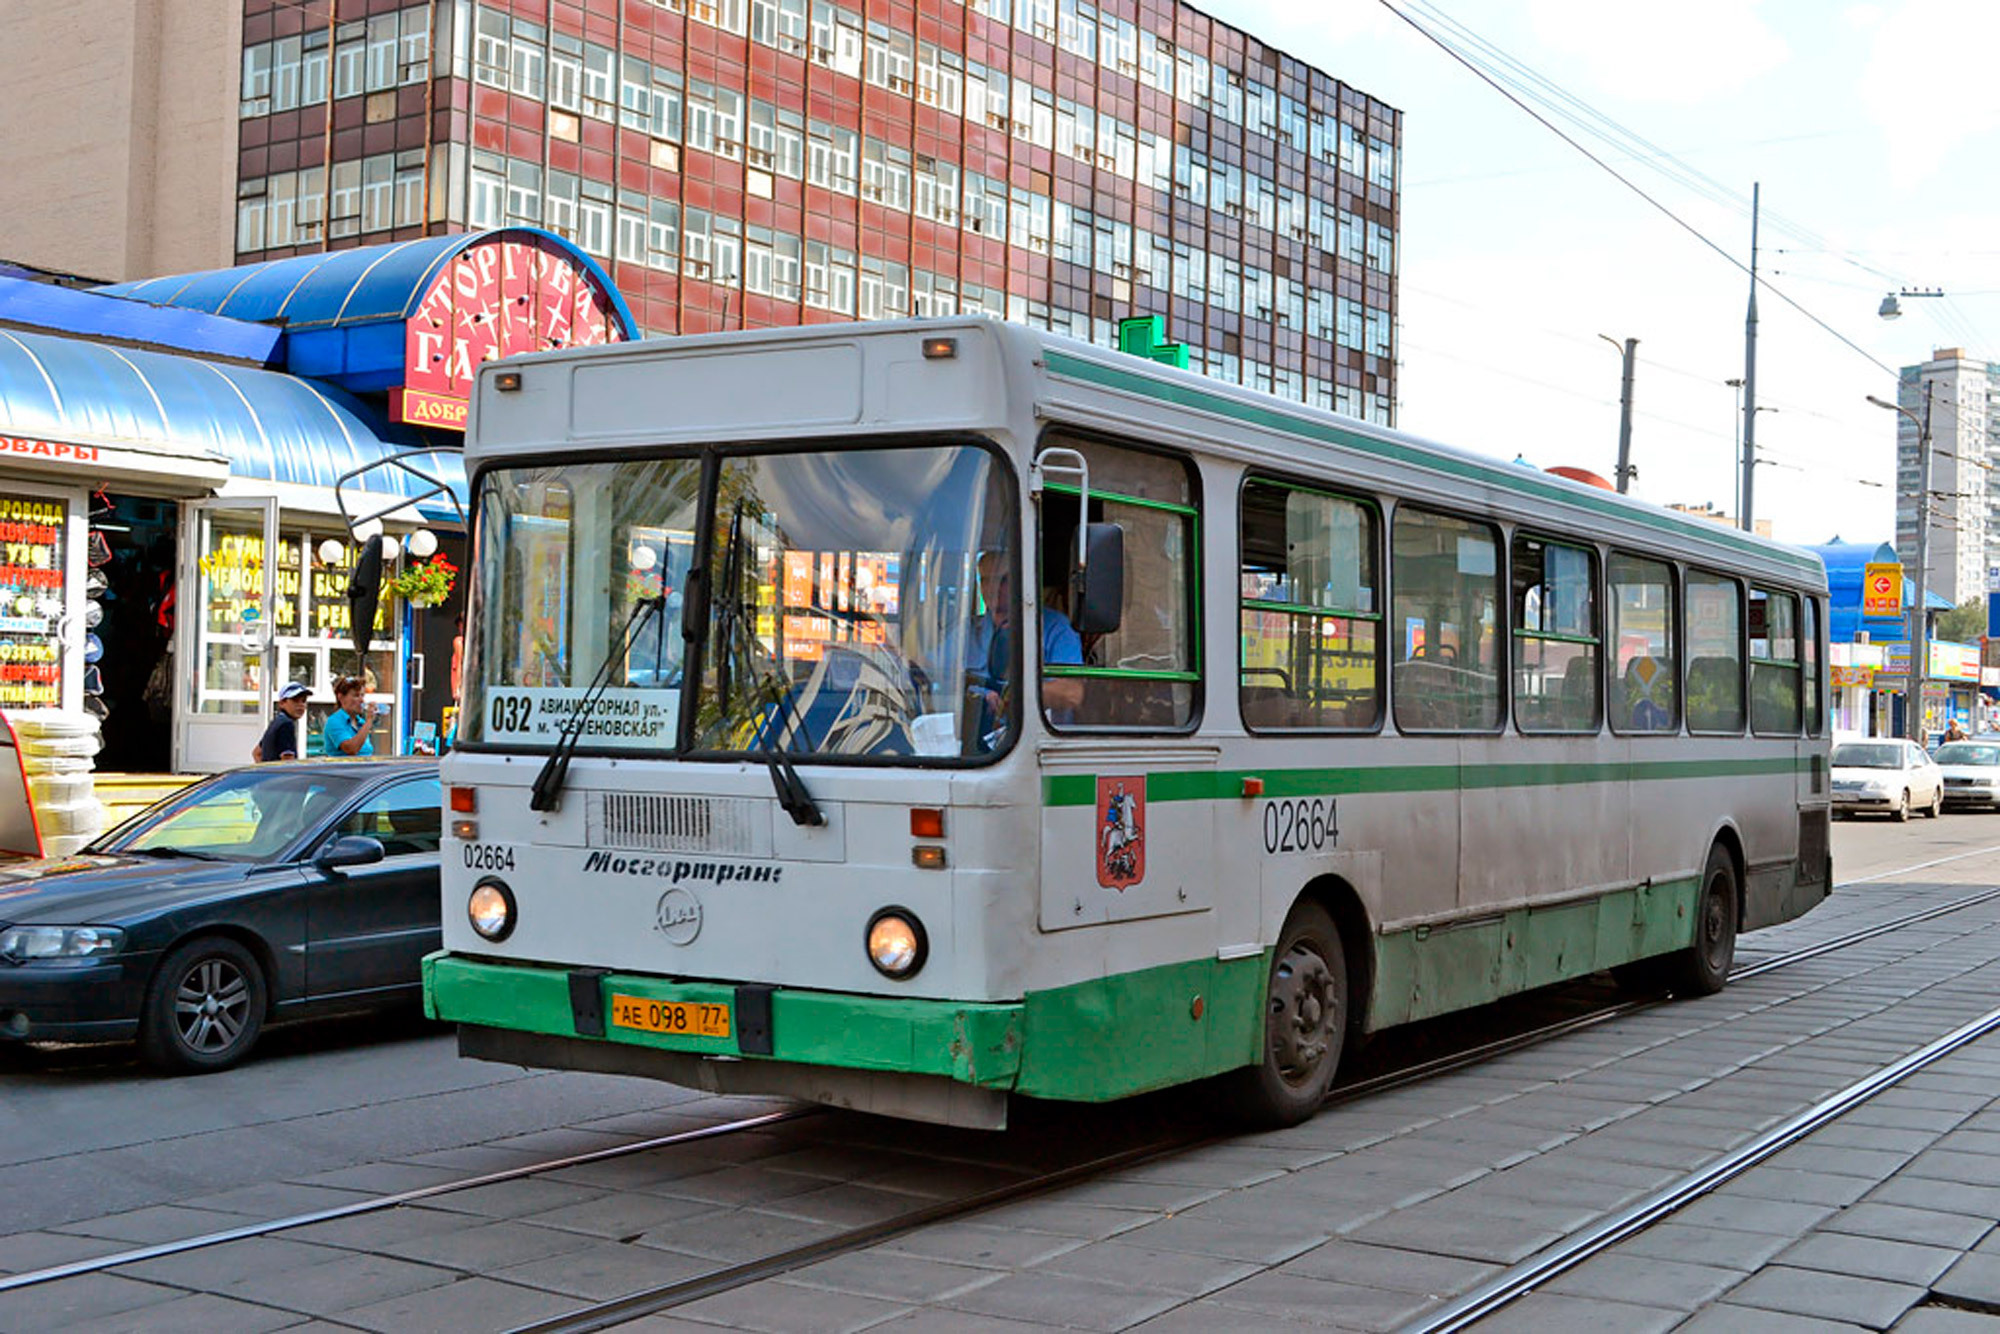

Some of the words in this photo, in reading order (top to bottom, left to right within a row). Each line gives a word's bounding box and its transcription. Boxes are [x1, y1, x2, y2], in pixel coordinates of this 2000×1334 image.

[0, 500, 63, 526] РОВОДА
[210, 566, 299, 595] ЧЕМОДНЫ
[492, 696, 532, 733] 032
[539, 698, 640, 716] АВИАМОТОРНАЯ
[1264, 798, 1339, 854] 02664
[464, 843, 516, 872] 02664
[584, 851, 783, 885] Мосгортранс
[650, 1004, 687, 1031] 098
[701, 1006, 722, 1026] 77
